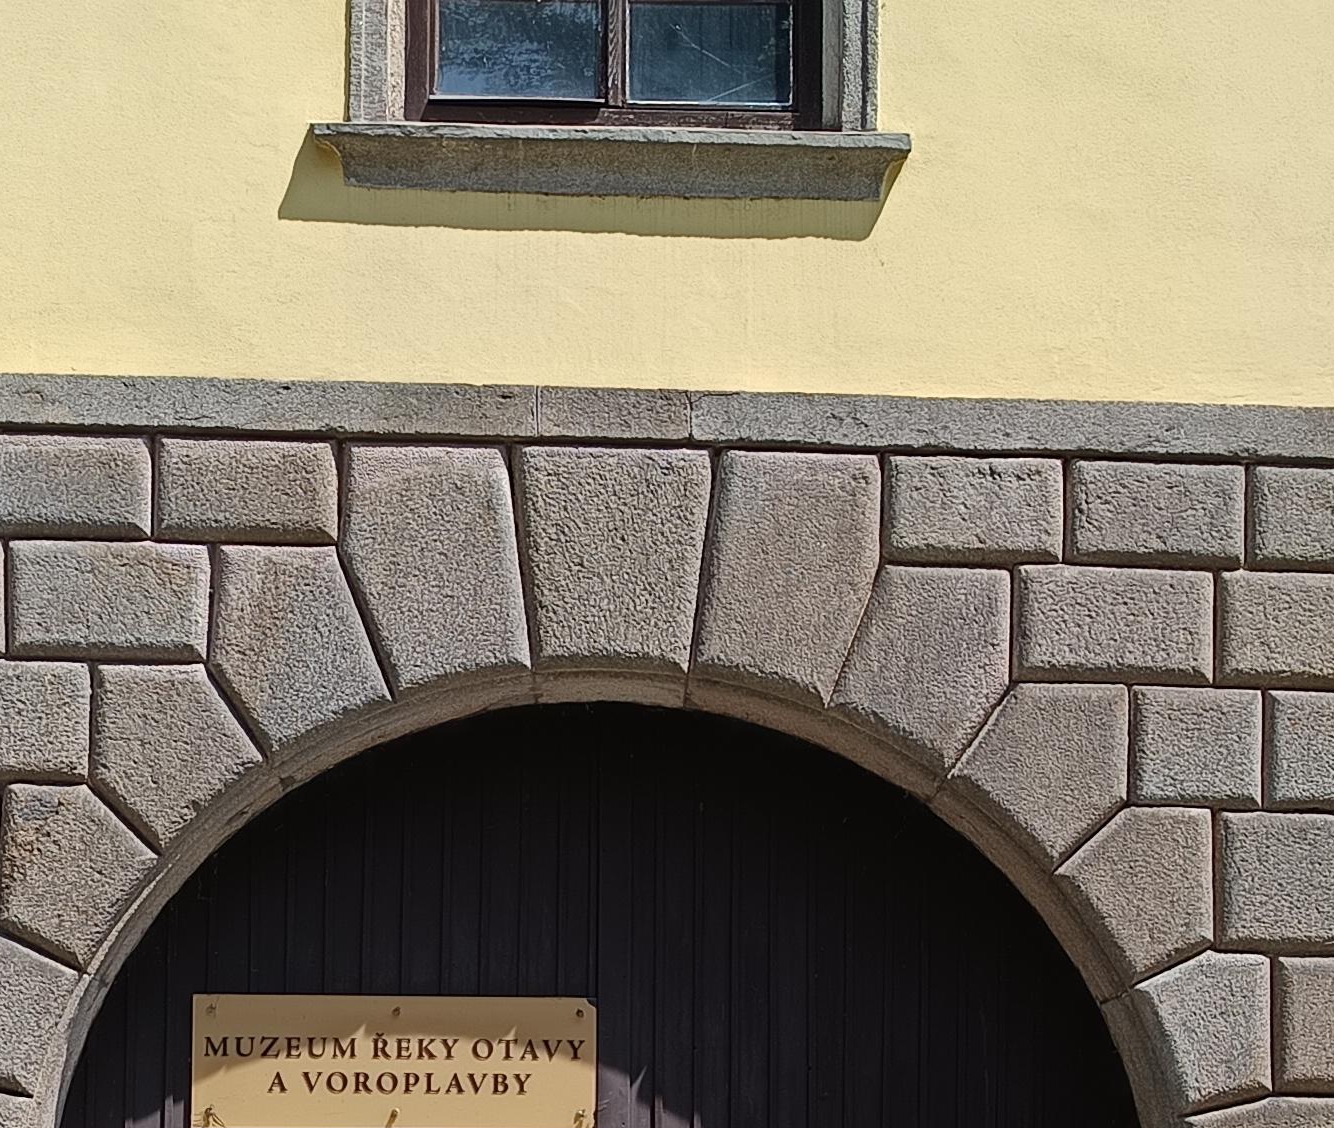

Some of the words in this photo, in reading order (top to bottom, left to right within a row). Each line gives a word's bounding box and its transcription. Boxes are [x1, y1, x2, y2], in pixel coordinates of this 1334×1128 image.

[204, 1035, 358, 1060] MUZEUM
[371, 1032, 461, 1061] ŘEKY
[471, 1037, 586, 1061] OTAVY
[266, 1072, 288, 1094] A
[301, 1071, 533, 1096] VOROPLAVBY
